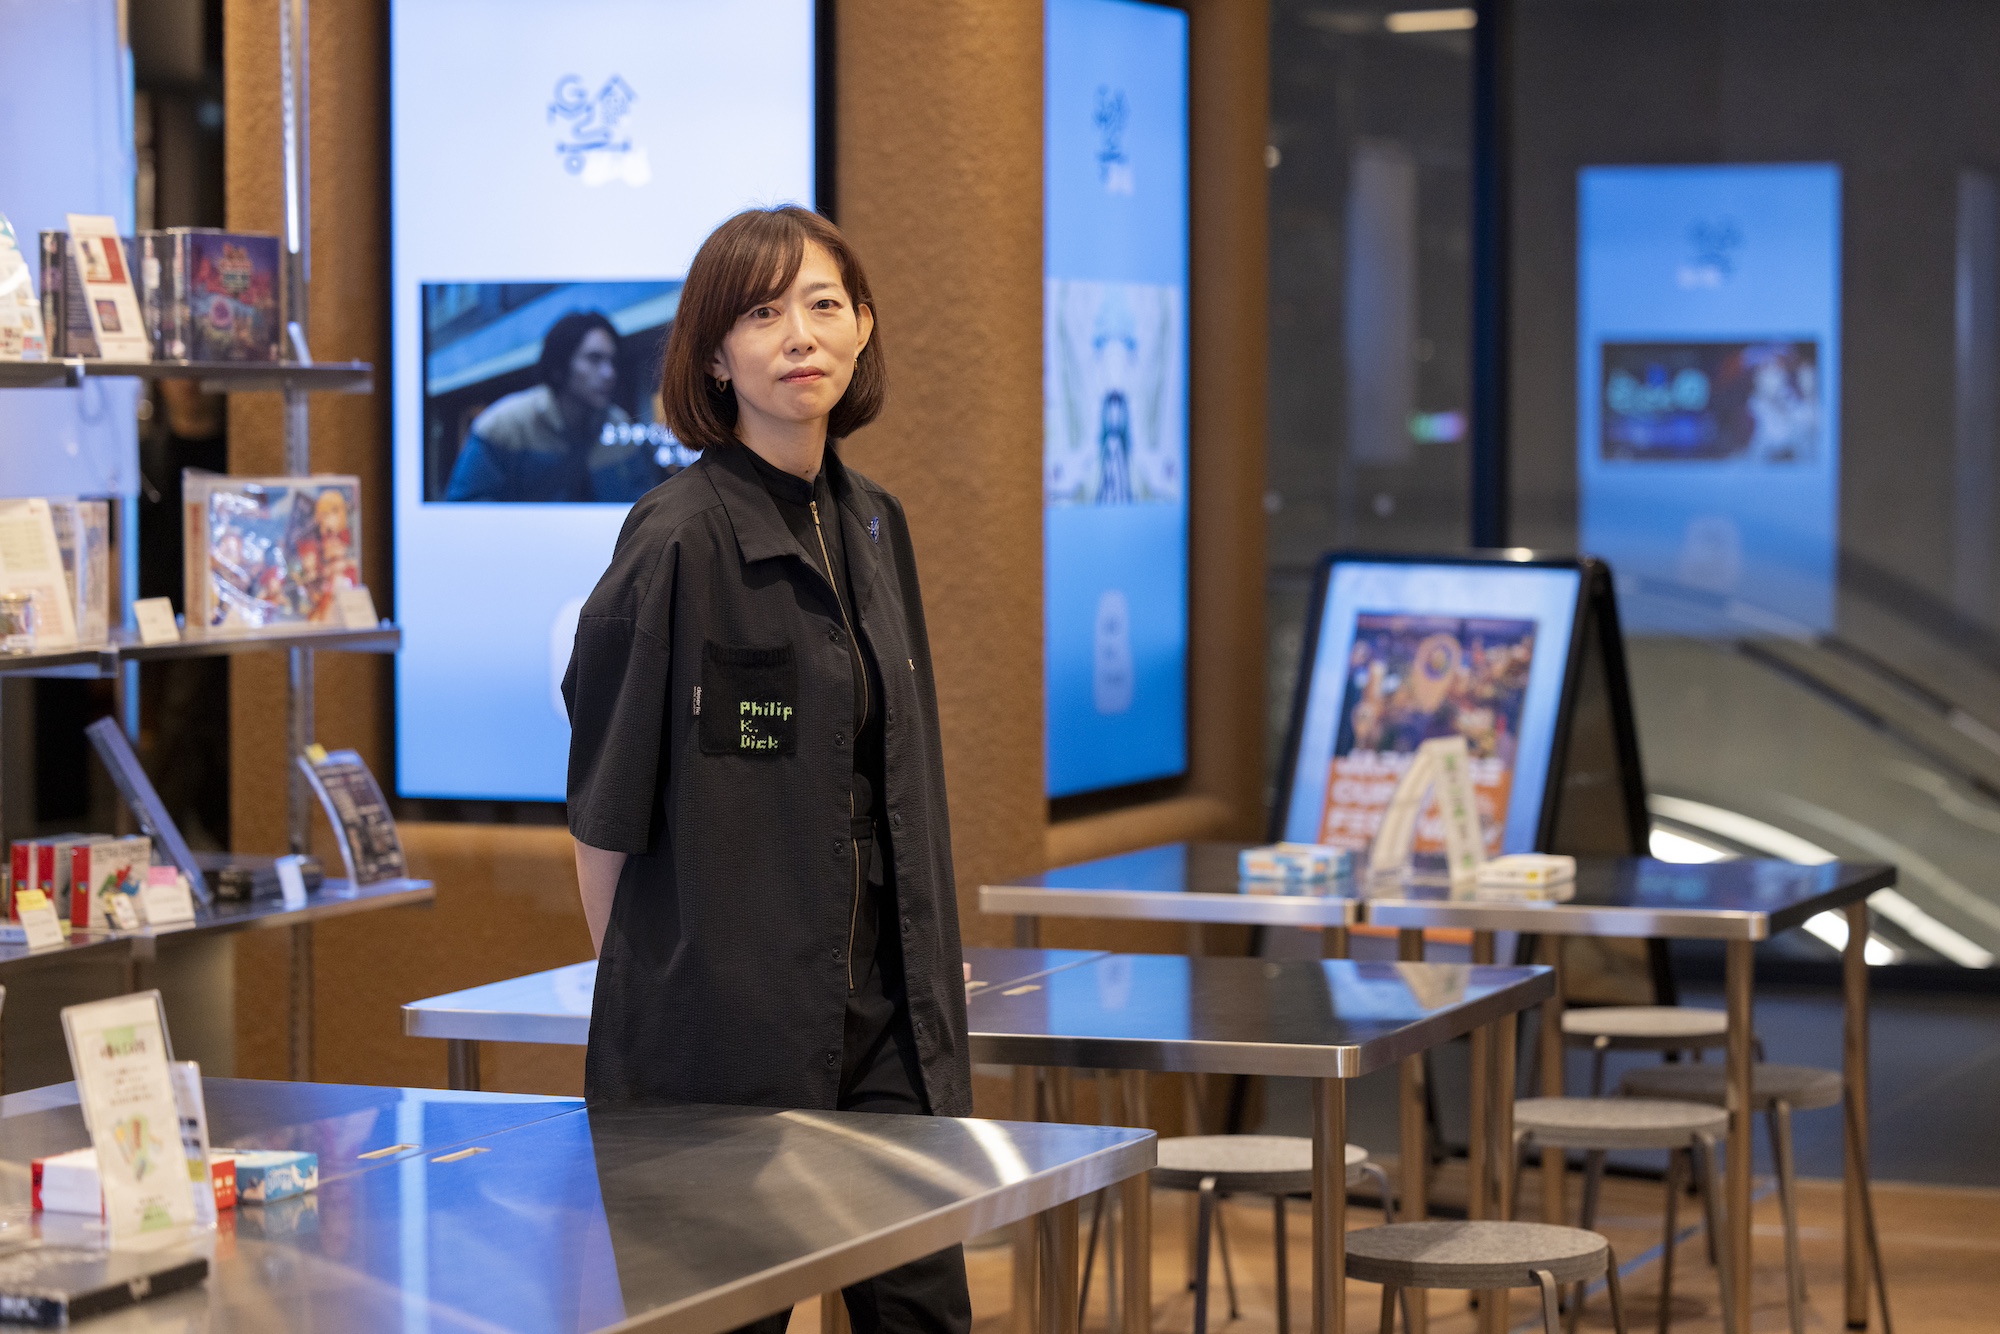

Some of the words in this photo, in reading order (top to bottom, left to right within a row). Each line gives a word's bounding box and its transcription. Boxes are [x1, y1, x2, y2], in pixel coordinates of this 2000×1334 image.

[740, 701, 793, 721] Philip
[740, 719, 759, 733] K.
[740, 734, 779, 750] Dick
